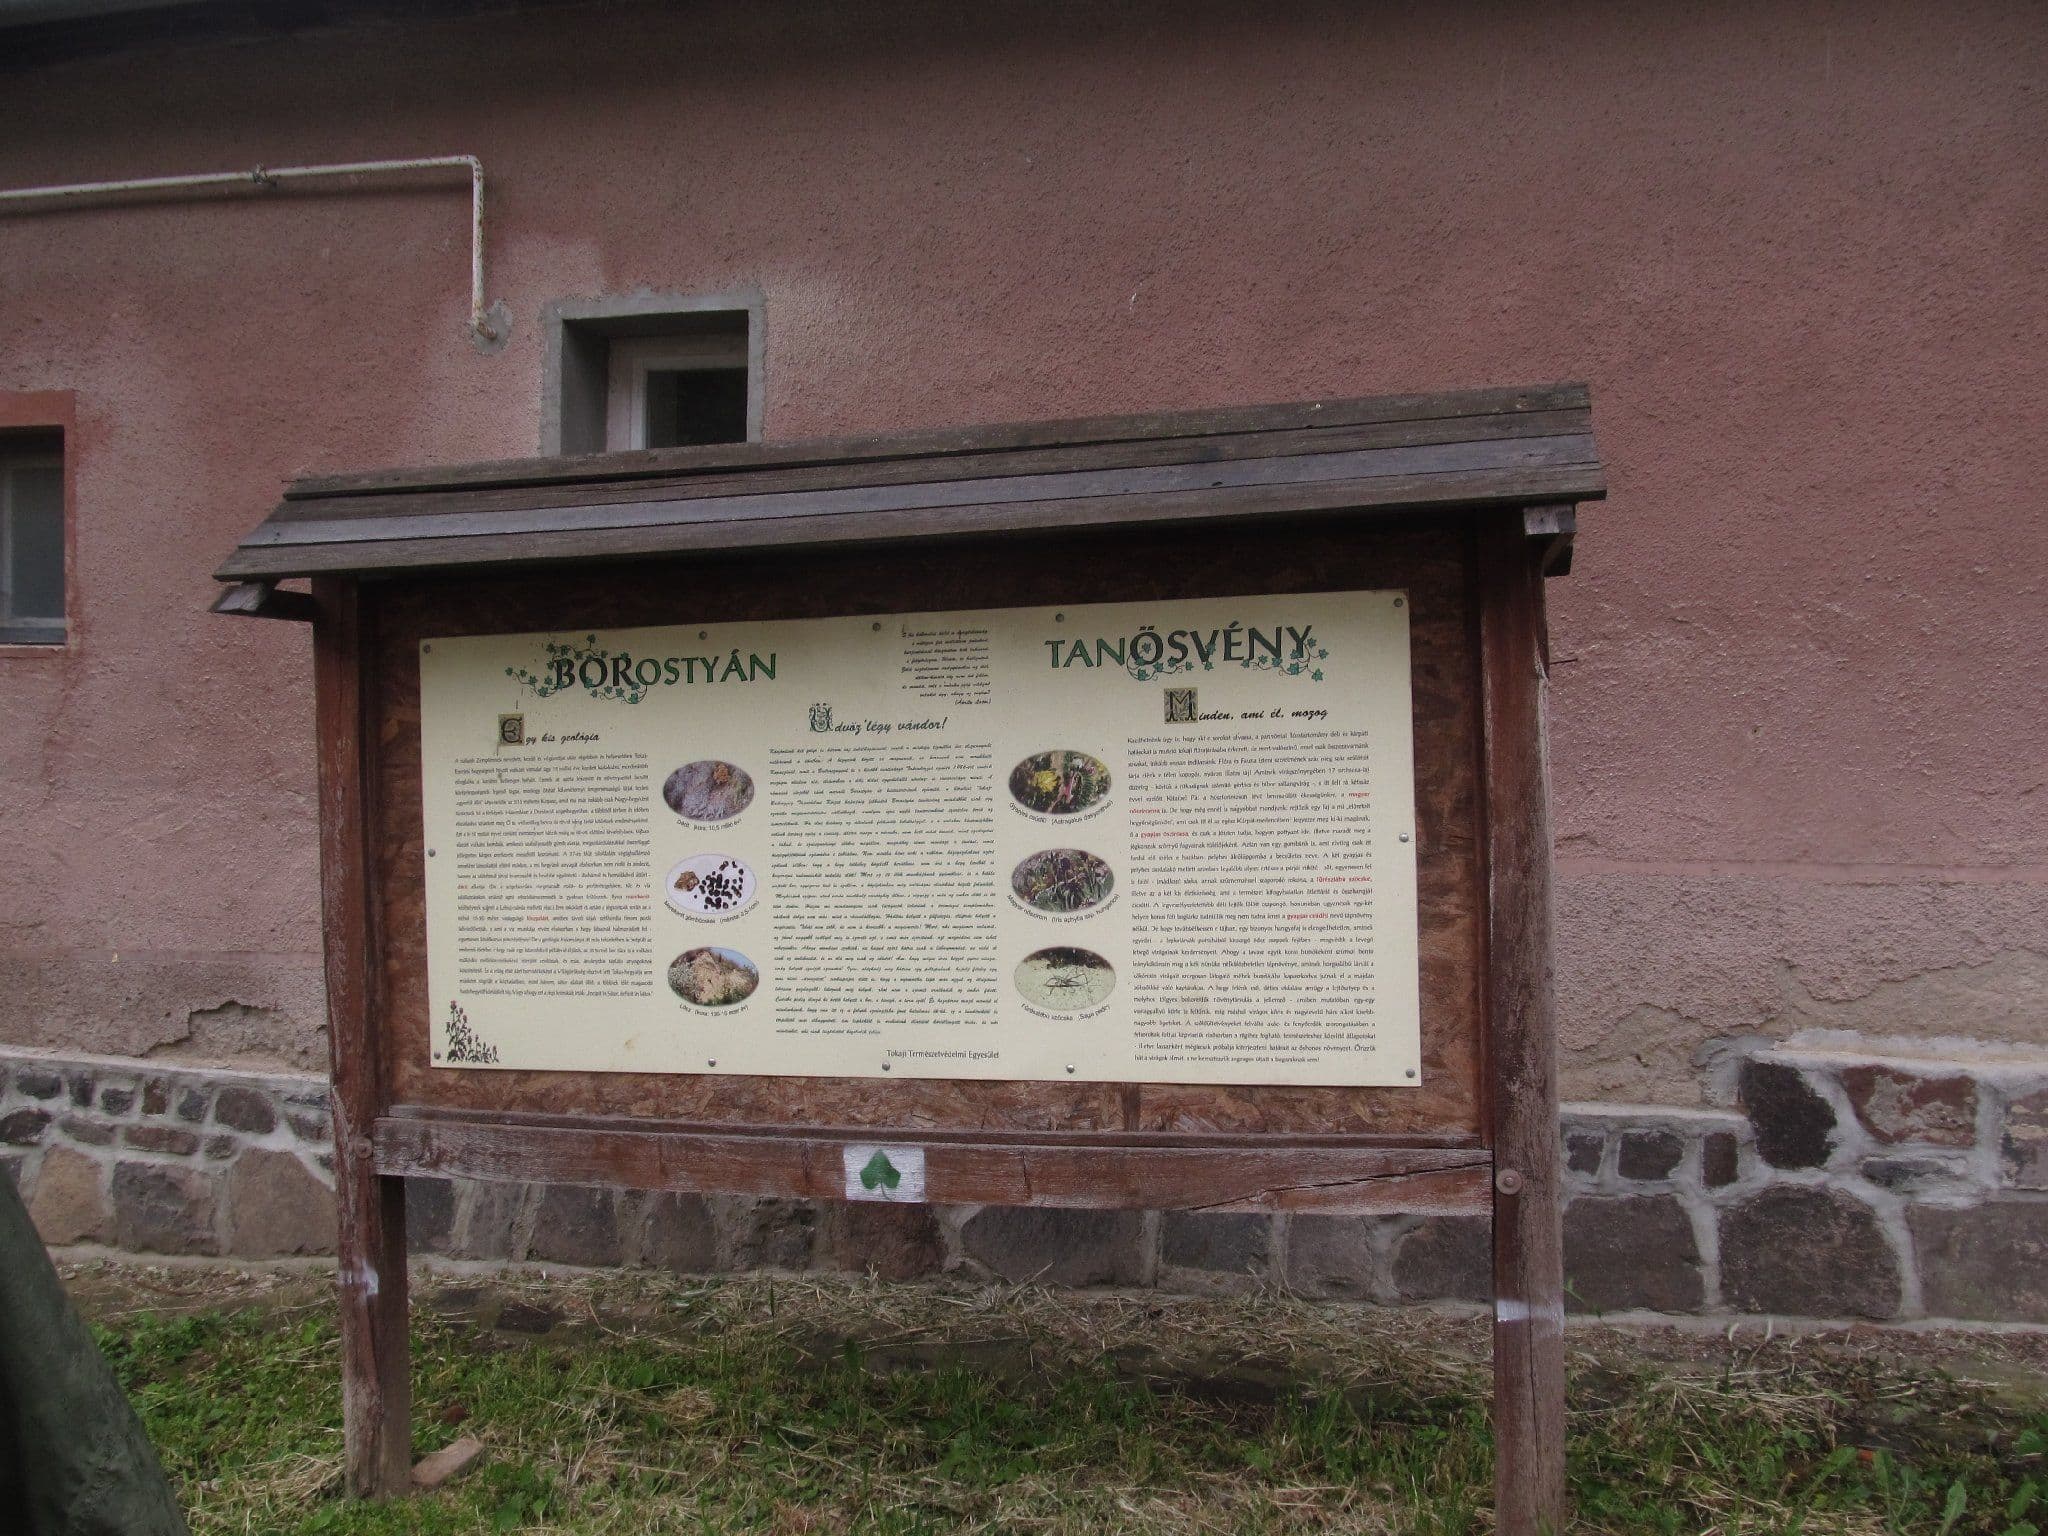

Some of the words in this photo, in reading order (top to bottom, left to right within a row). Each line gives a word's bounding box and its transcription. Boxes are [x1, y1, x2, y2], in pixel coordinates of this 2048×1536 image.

[1240, 710, 1264, 720] ami
[1291, 708, 1328, 721] mozog
[897, 716, 948, 731] vándor!
[541, 732, 557, 743] kis
[560, 731, 601, 745] geológia
[886, 1049, 907, 1059] Tokaji
[908, 1049, 967, 1059] Természetvédelmi
[968, 1050, 1000, 1060] Egyesület
